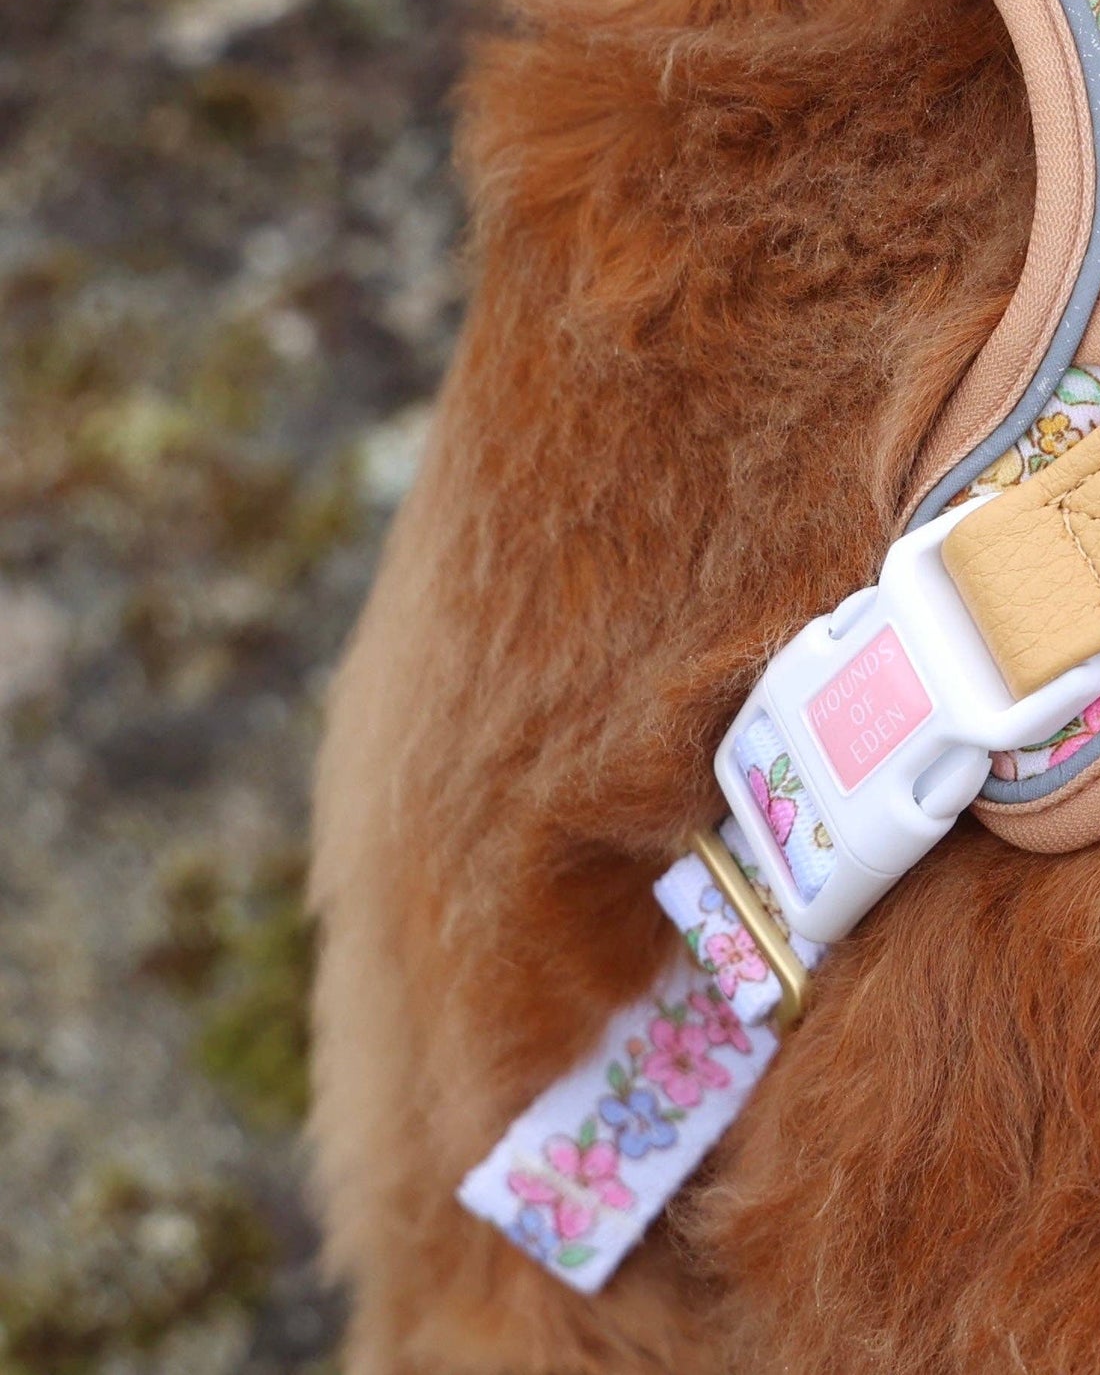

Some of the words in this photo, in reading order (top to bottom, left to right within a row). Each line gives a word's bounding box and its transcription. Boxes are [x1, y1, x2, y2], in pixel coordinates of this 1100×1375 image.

[812, 639, 895, 727] HOUNDS
[850, 690, 875, 725] OF
[850, 704, 906, 764] EDEN
